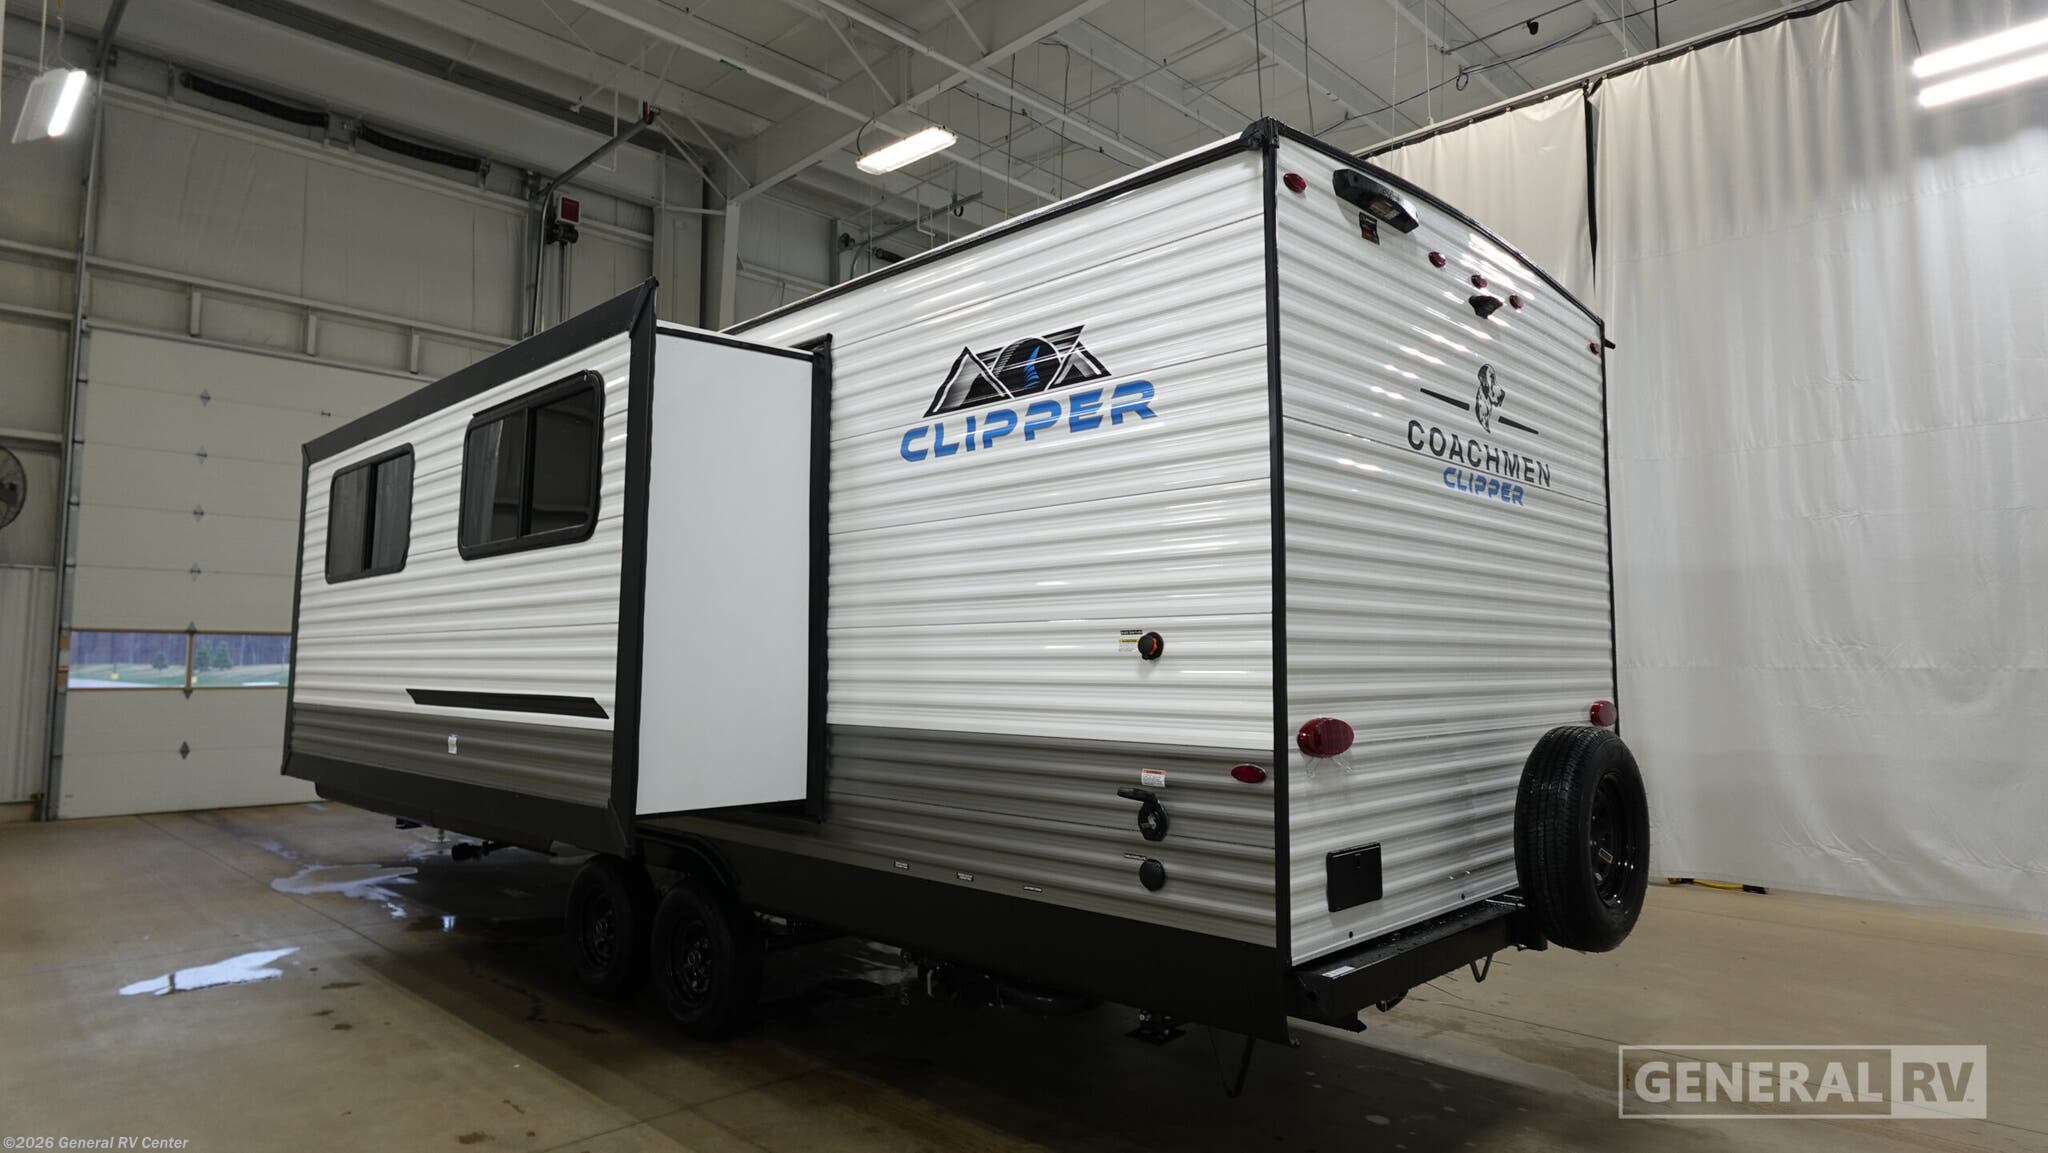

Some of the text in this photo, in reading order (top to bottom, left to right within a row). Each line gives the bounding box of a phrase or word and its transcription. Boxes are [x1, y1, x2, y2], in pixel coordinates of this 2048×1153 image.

[900, 380, 1158, 462] CLIPPER
[1408, 420, 1551, 487] COACHMEN
[1443, 467, 1524, 506] CLIPPER
